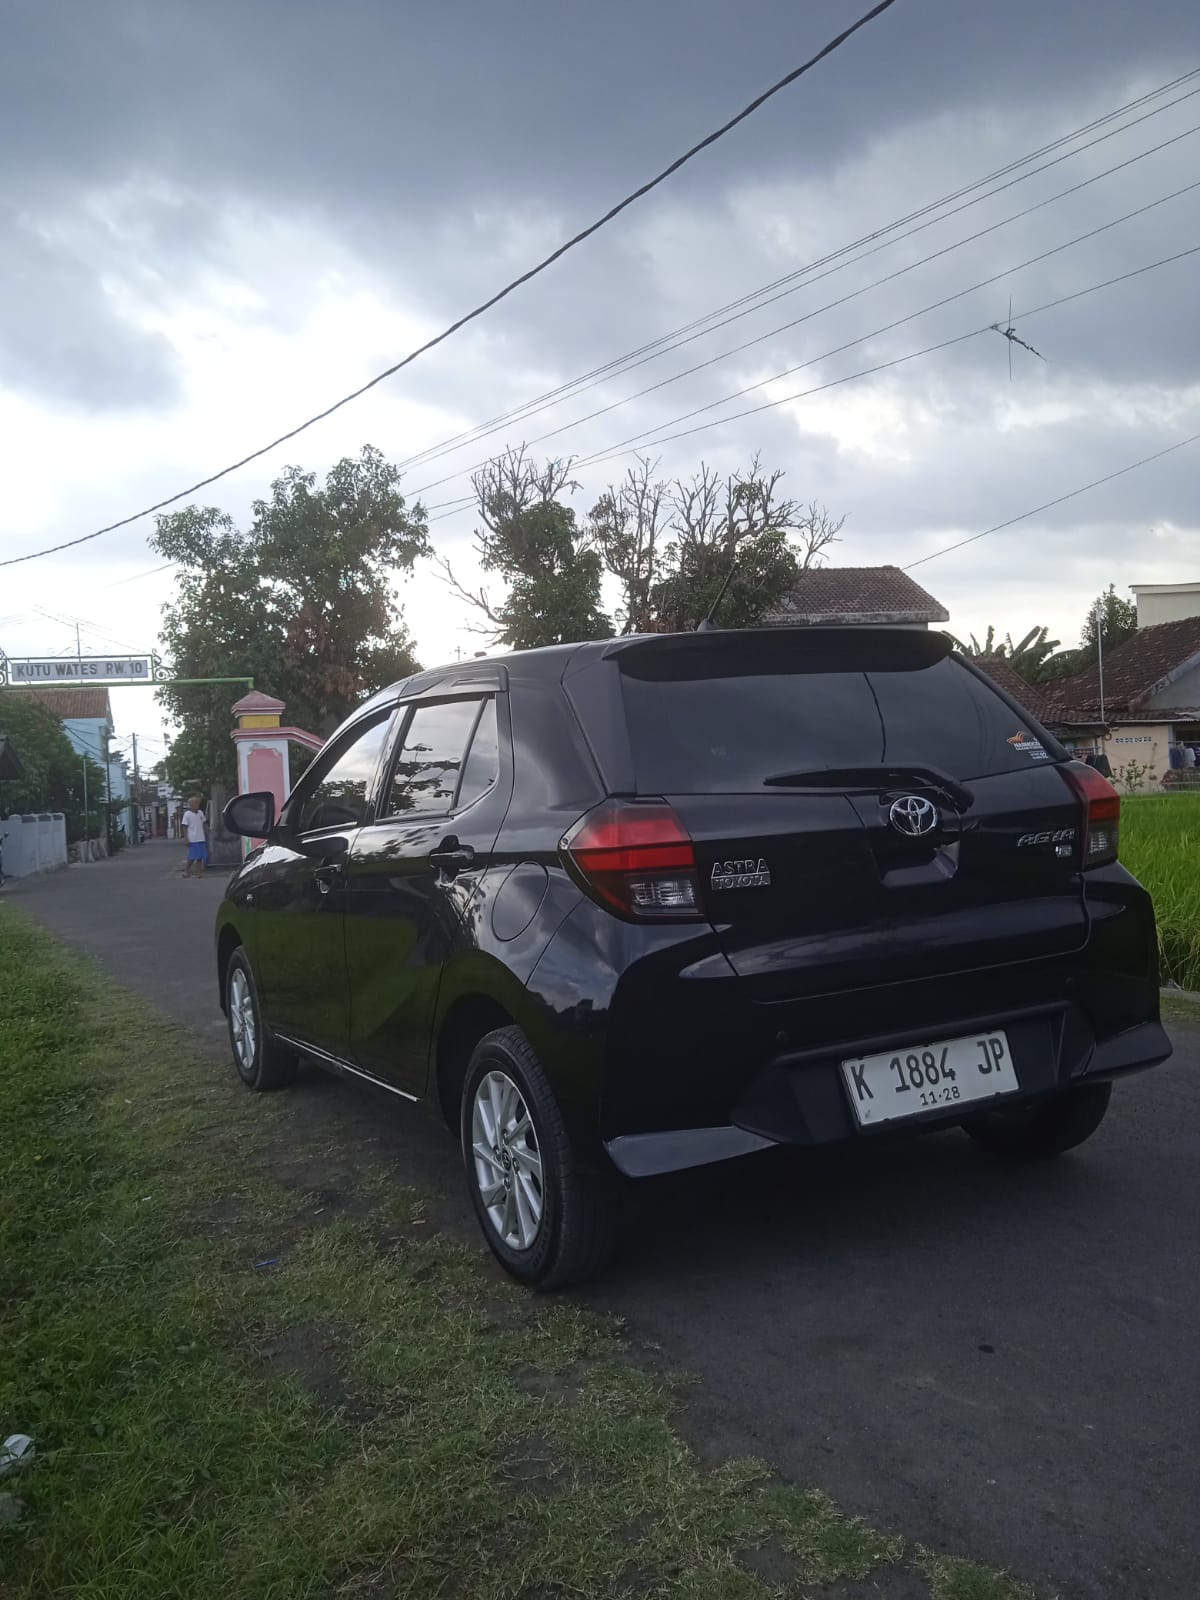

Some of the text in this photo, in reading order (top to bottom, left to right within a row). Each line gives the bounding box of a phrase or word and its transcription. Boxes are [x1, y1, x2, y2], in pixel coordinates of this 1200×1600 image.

[16, 664, 51, 677] KUTU
[55, 663, 97, 676] WATES
[130, 662, 142, 674] 10
[711, 858, 769, 877] ASTRA
[714, 875, 769, 888] TOYOTA
[850, 1037, 1005, 1100] K 1884 JP
